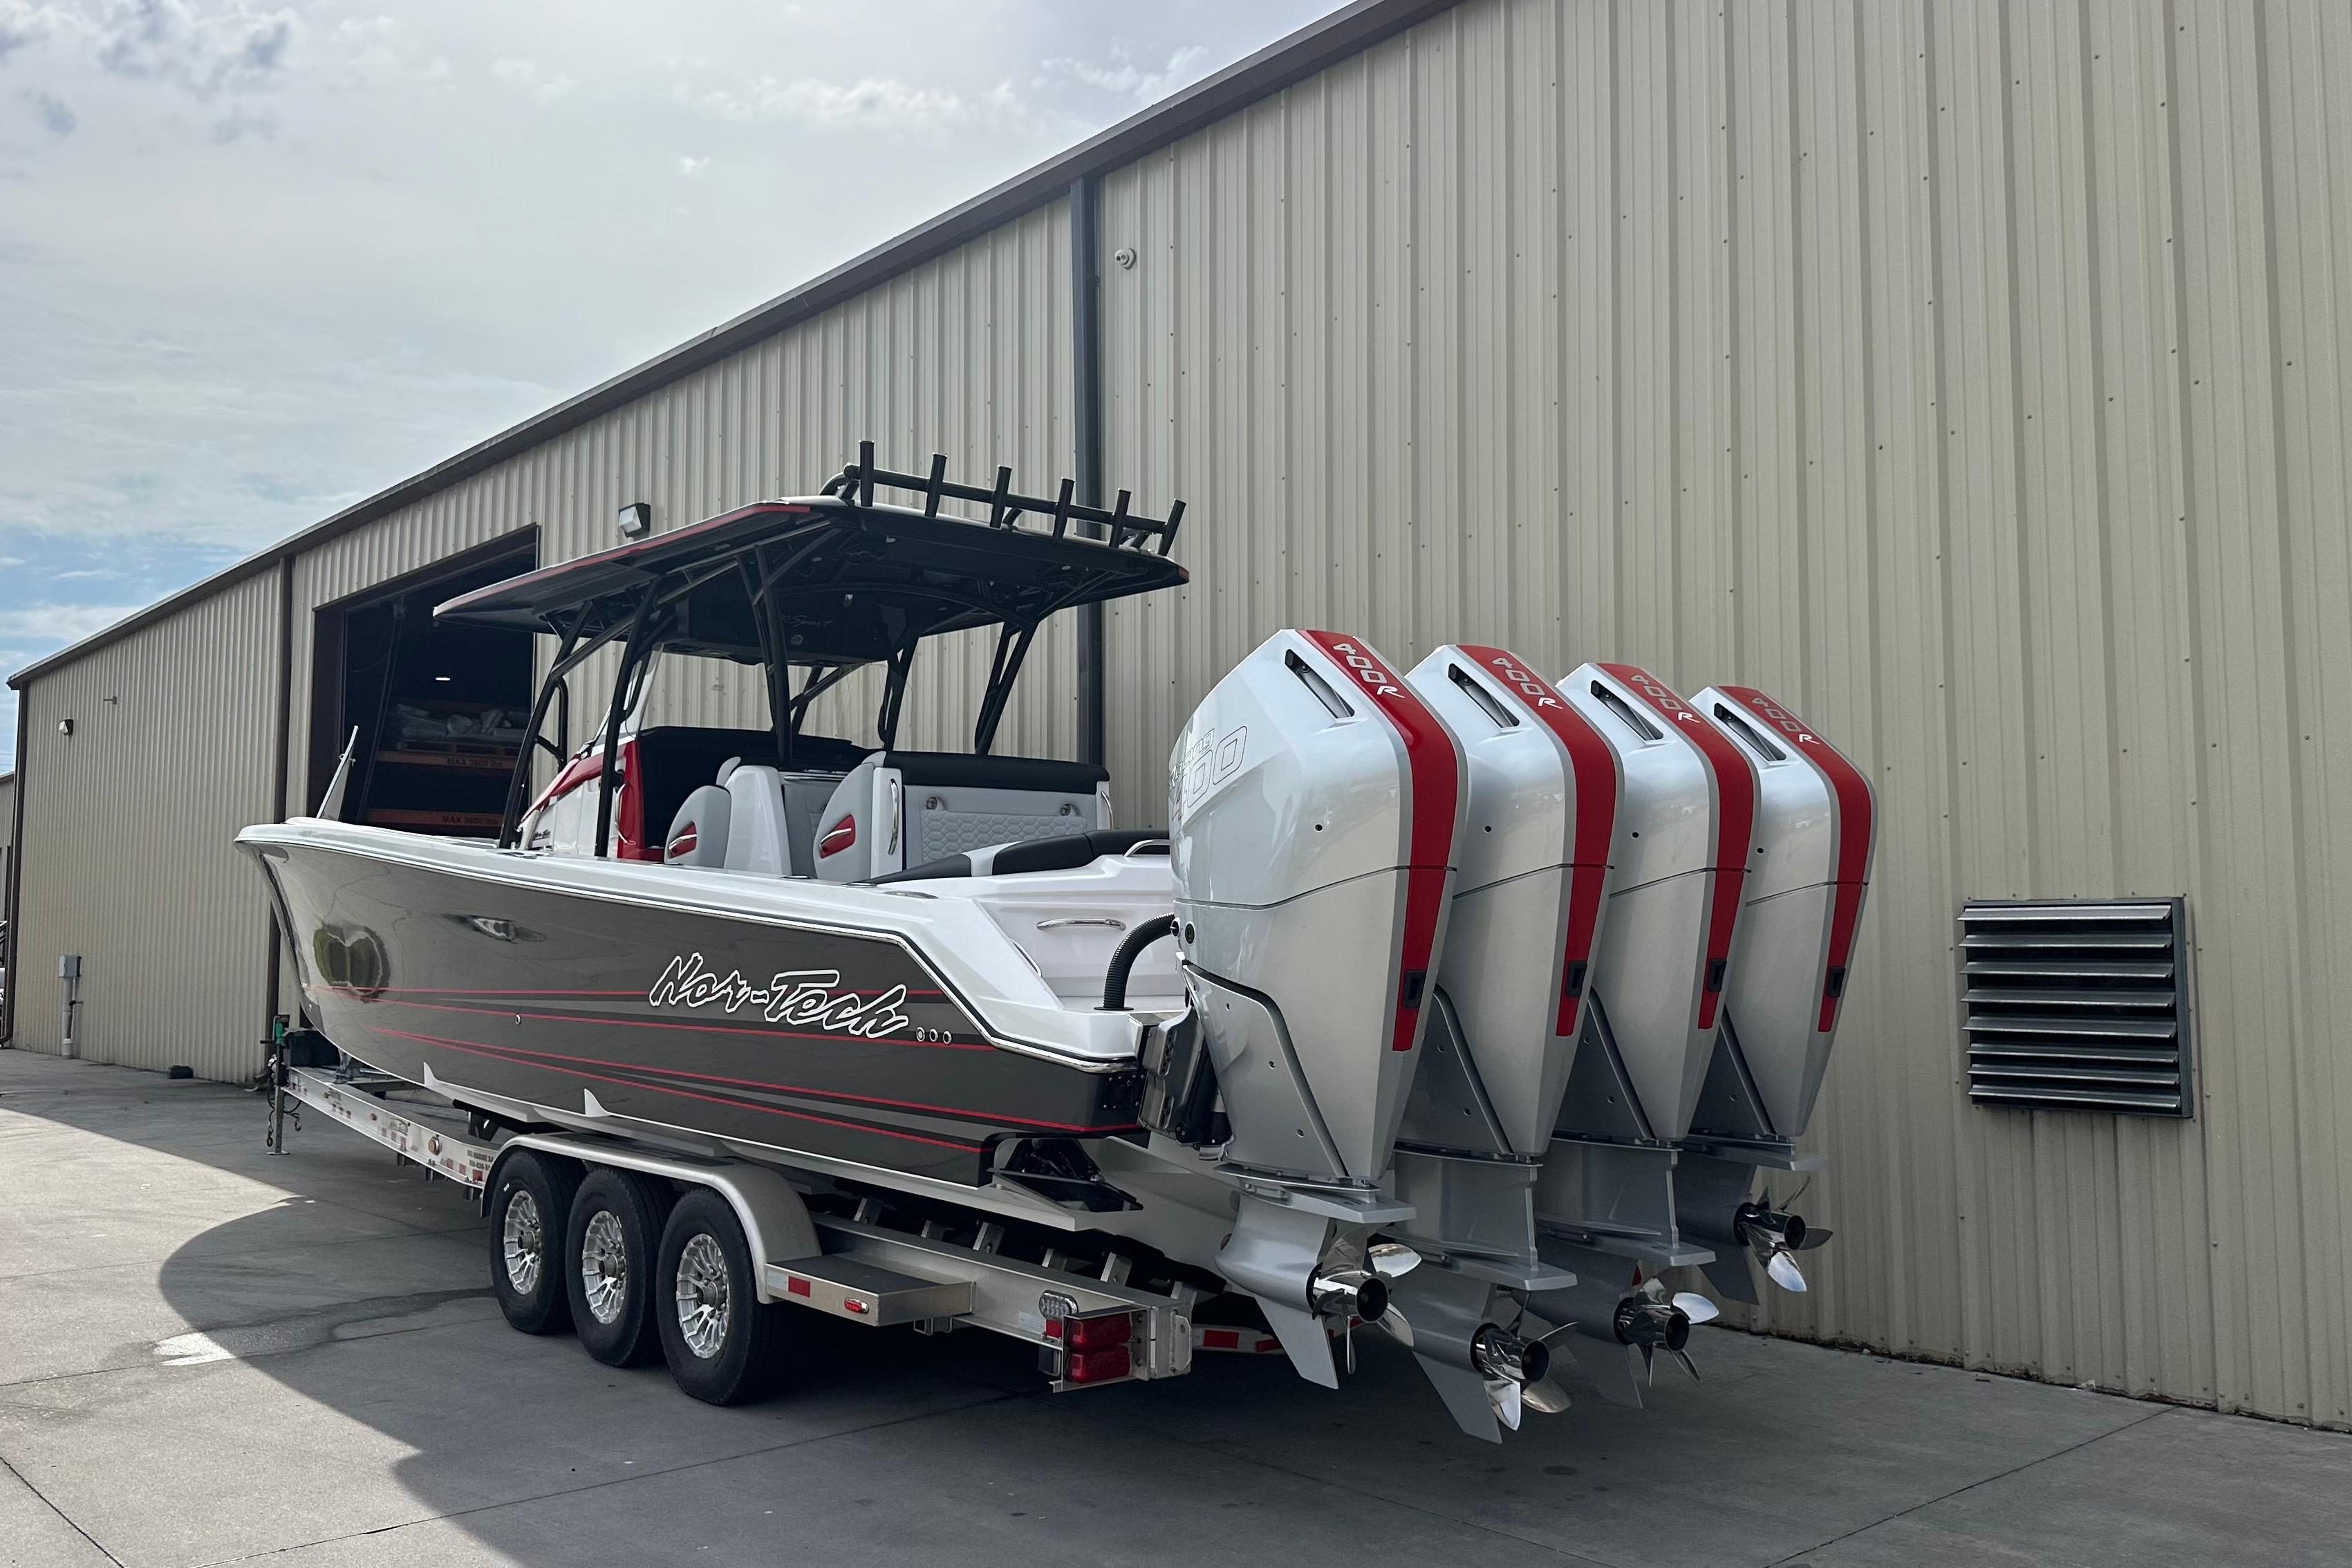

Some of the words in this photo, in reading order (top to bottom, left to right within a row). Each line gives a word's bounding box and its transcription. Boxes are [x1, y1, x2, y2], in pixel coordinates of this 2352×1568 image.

[1332, 642, 1406, 698] 400R
[1491, 657, 1564, 709] 400R
[1630, 674, 1701, 723] 400R
[1751, 697, 1820, 745] 400R
[648, 952, 909, 1038] Nor-Tech
